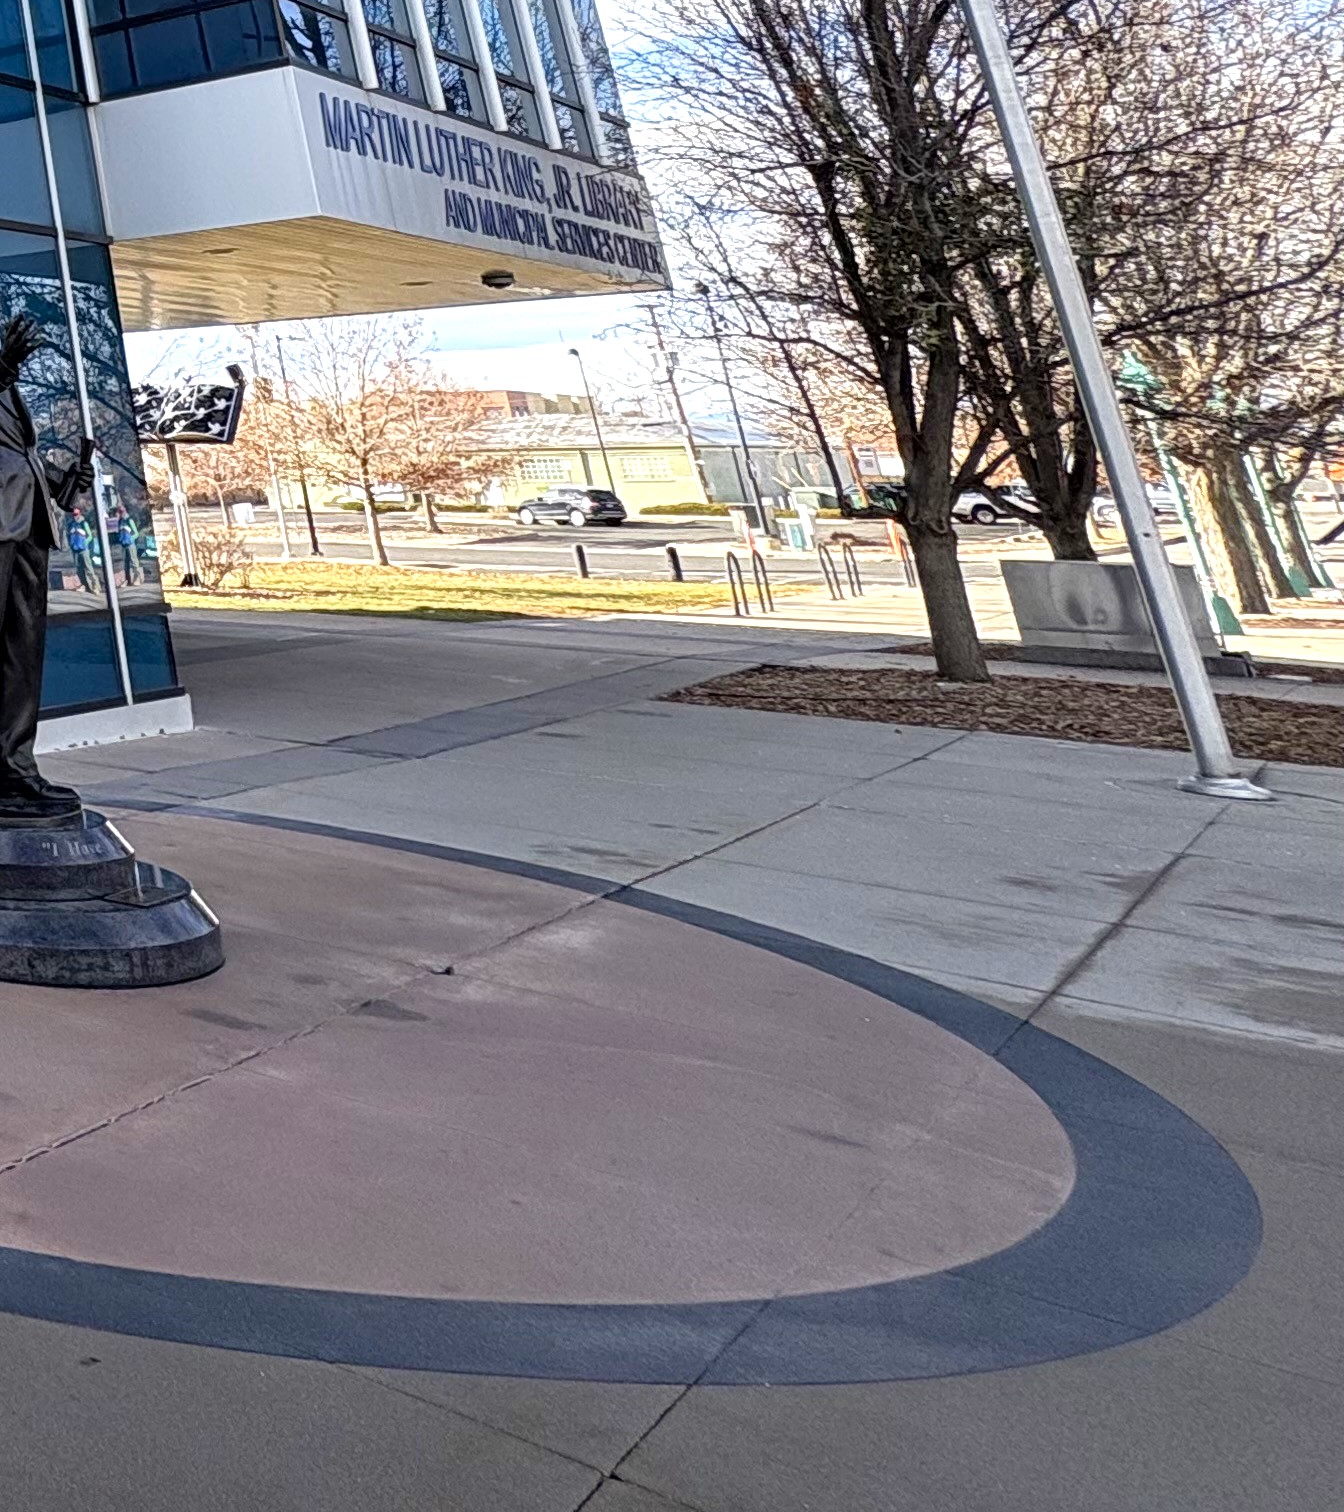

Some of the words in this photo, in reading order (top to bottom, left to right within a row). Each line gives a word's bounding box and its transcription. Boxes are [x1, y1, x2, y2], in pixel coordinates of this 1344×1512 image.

[319, 92, 414, 169] MARTIN
[413, 120, 501, 192] LUTHER
[497, 146, 552, 214] KING,
[576, 171, 645, 231] LIBRARY
[444, 188, 478, 233] AND
[476, 196, 555, 251] MUNICIPAL
[552, 216, 615, 264] SERVICES
[614, 232, 663, 275] CENTER
